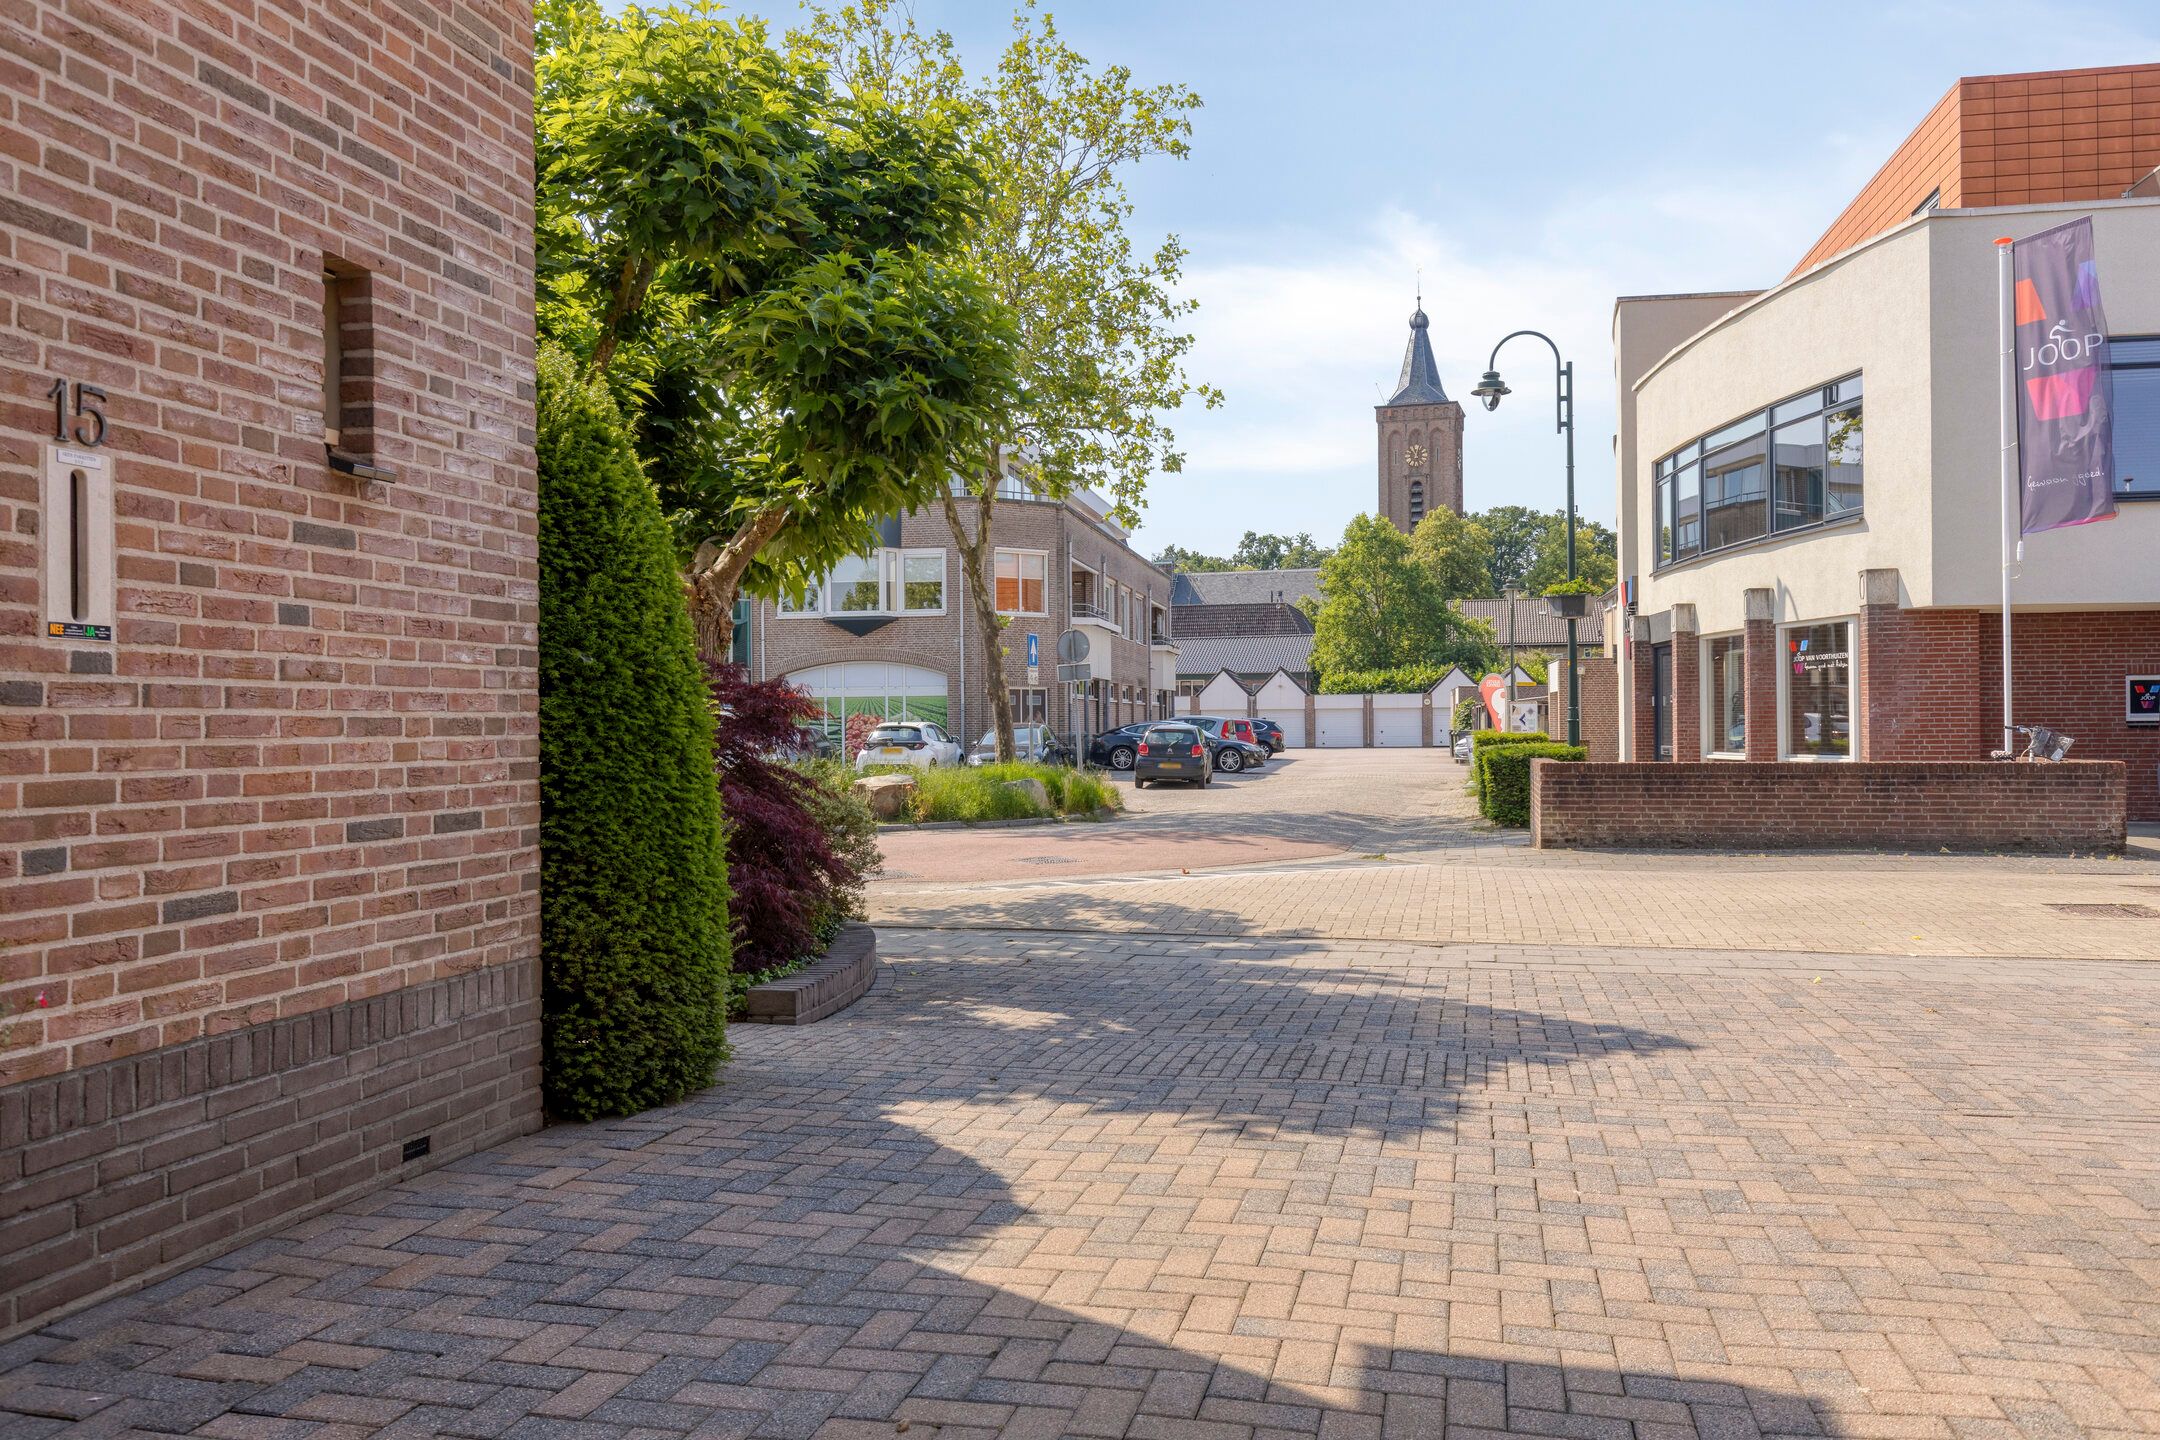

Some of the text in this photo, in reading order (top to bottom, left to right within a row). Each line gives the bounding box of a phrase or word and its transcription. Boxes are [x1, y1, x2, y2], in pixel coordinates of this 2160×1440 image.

[2023, 333, 2104, 371] JOOP
[47, 378, 108, 446] 15
[50, 623, 64, 635] NEE
[85, 626, 96, 637] JA
